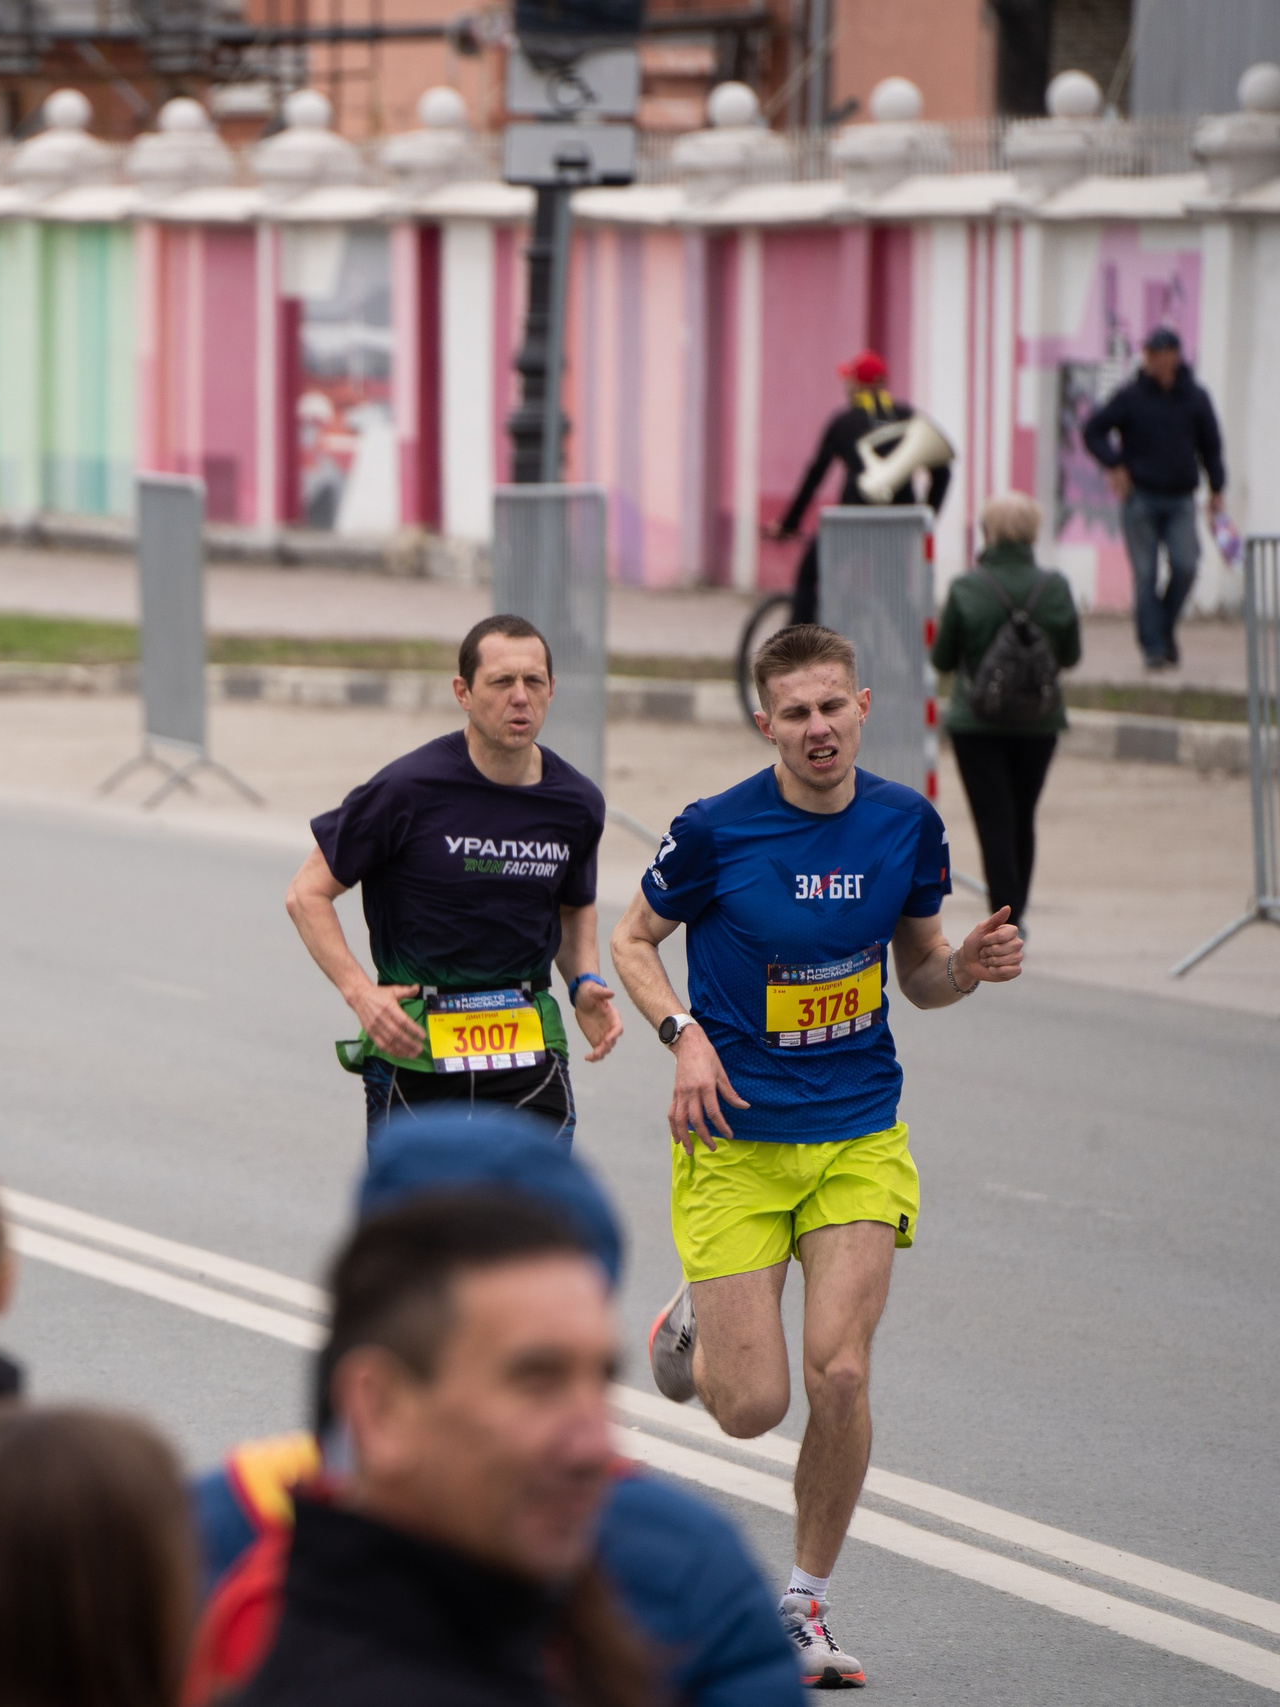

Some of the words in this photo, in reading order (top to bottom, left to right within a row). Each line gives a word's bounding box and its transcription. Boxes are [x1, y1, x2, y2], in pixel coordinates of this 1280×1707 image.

[444, 835, 569, 862] УРАЛХИМ
[815, 960, 853, 974] ПРОСТО
[813, 981, 843, 992] АНДРЕЙ
[465, 1012, 499, 1021] ДМИТРИЙ
[797, 987, 859, 1027] 3178
[452, 1022, 519, 1053] 3007
